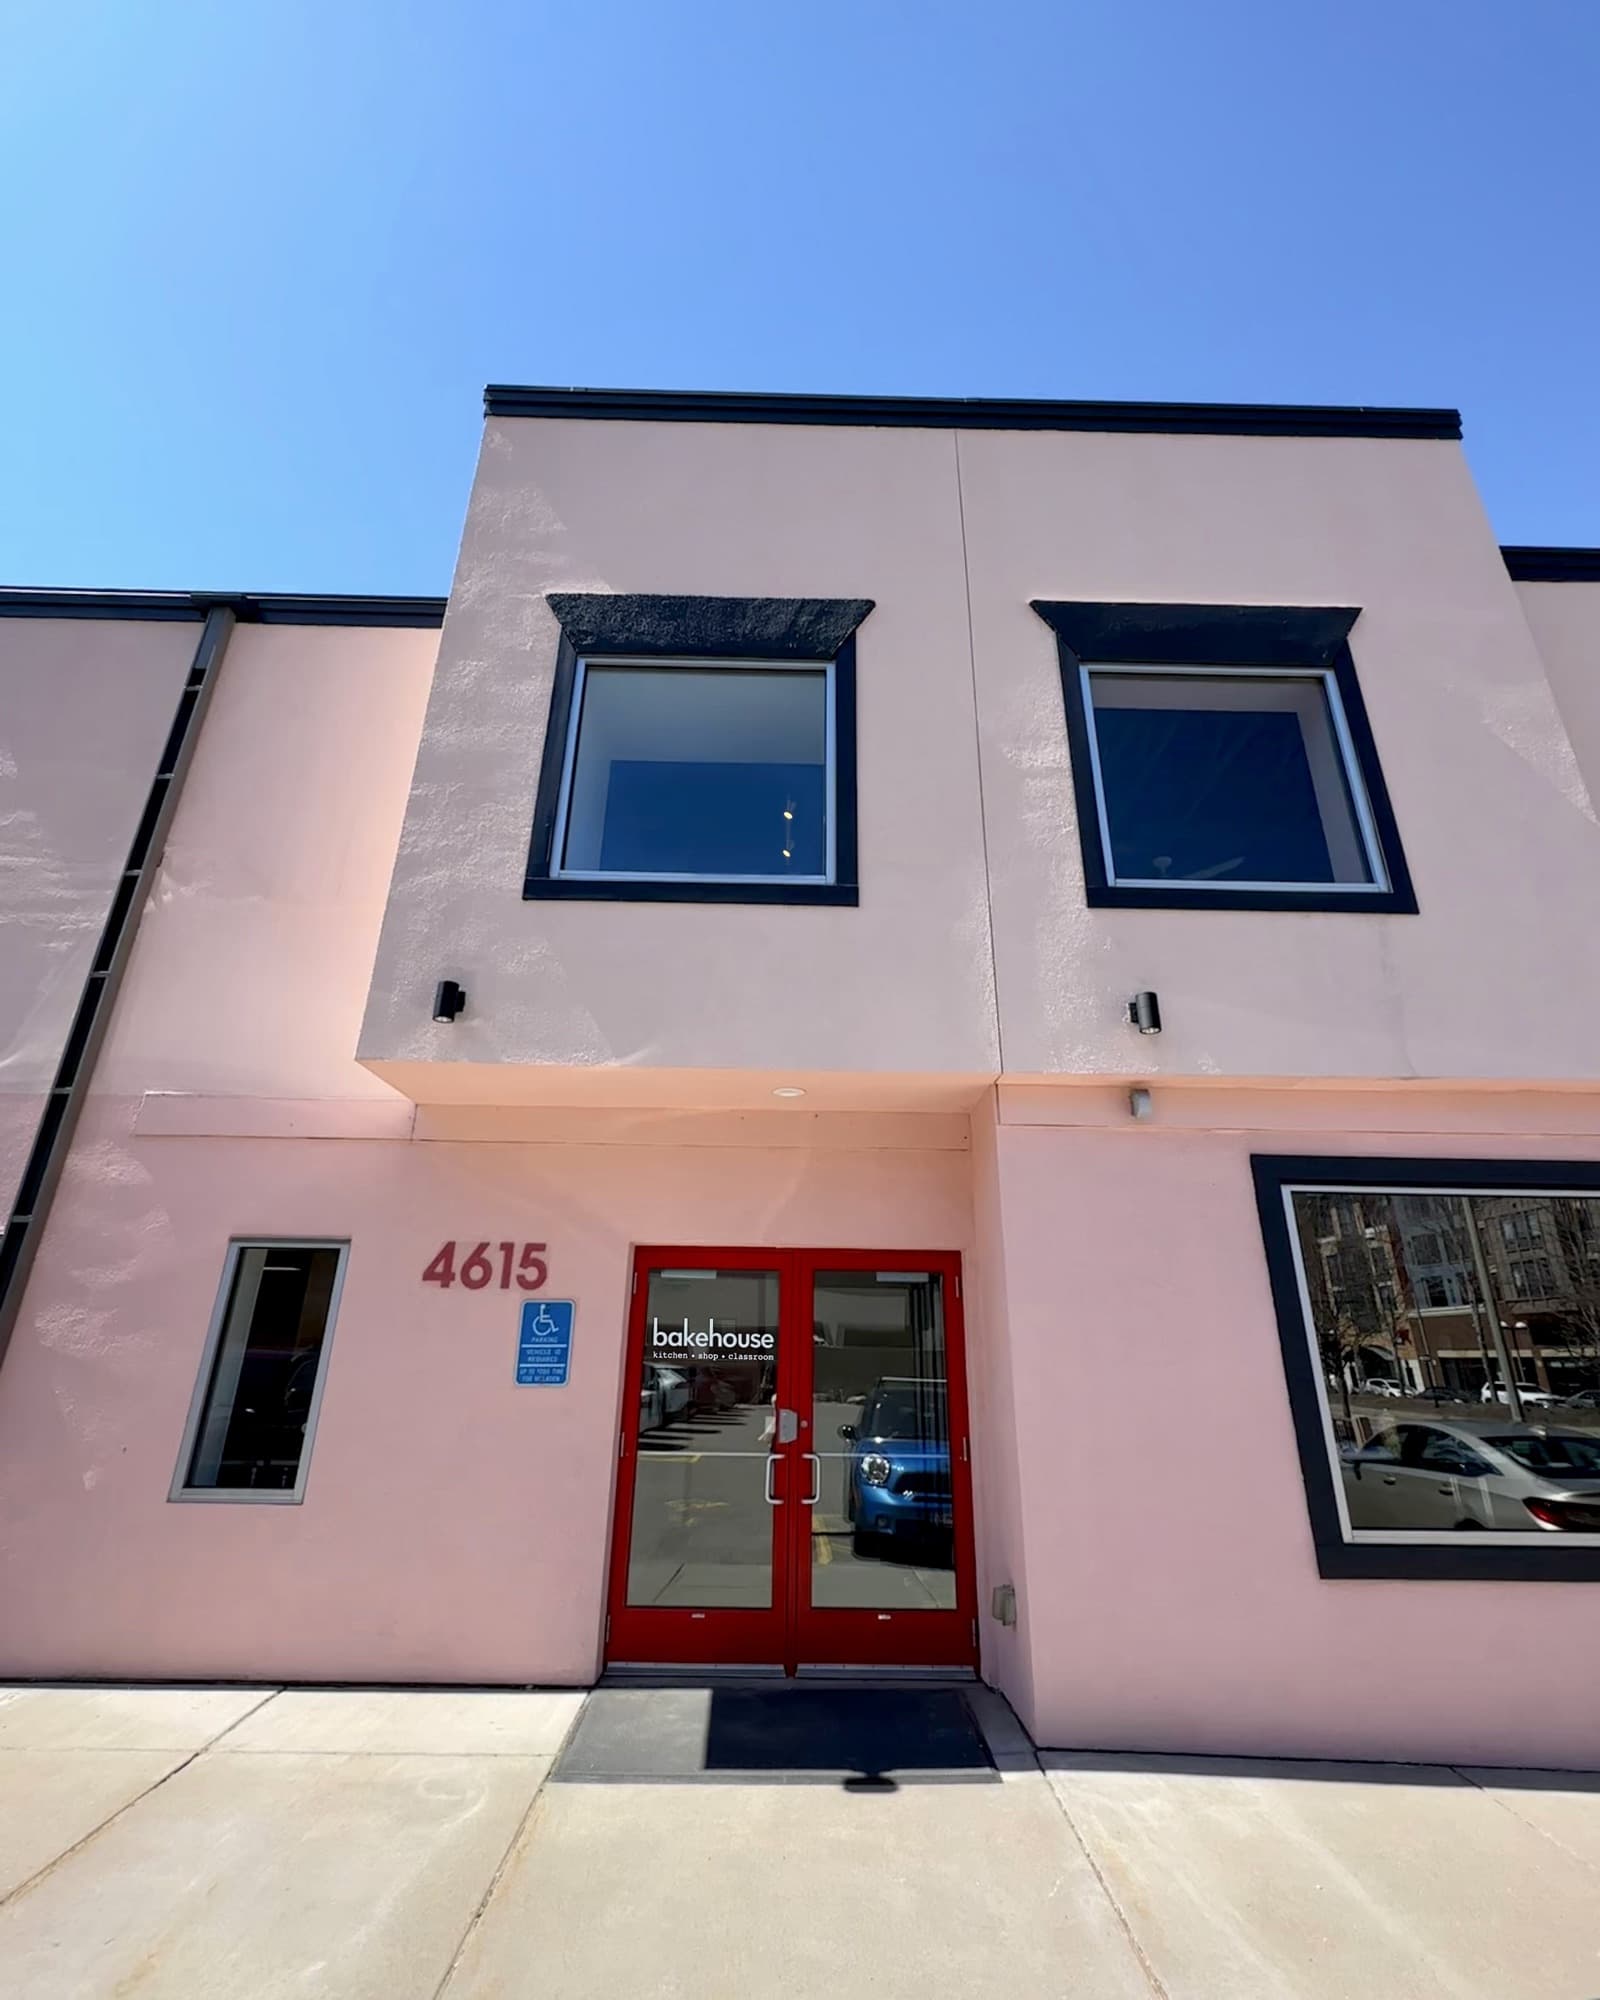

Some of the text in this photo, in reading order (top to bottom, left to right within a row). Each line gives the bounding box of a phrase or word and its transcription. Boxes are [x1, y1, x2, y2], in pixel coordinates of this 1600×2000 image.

[422, 1240, 547, 1290] 4615
[652, 1316, 775, 1349] bakehouse
[653, 1351, 774, 1361] kitchen shop classroom
